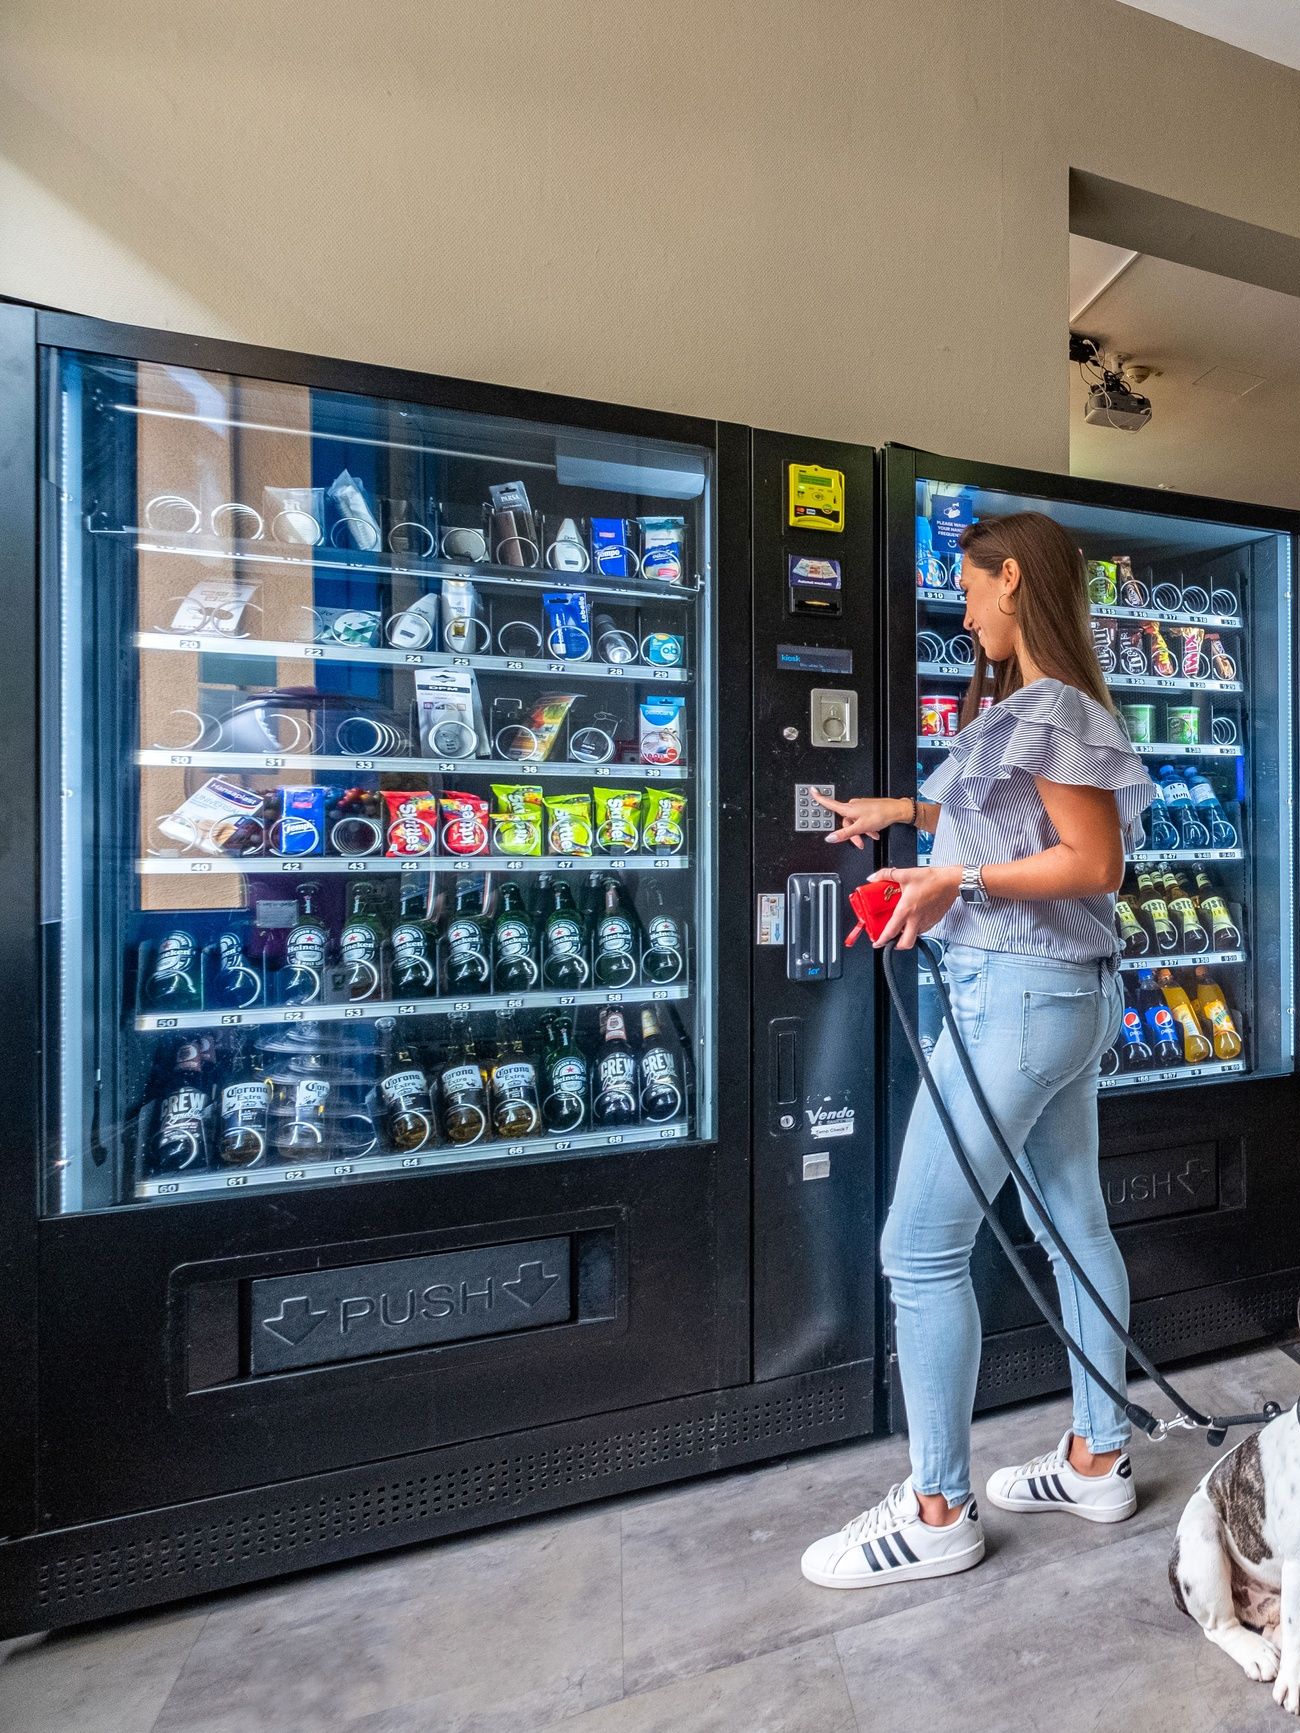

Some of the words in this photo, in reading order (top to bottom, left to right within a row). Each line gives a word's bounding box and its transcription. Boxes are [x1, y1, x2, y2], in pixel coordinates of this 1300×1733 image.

[181, 641, 199, 649] 20
[305, 648, 323, 656] 22
[406, 655, 422, 663] 24
[454, 658, 470, 666] 25
[508, 661, 523, 669] 26
[942, 666, 958, 674] 920
[655, 671, 668, 679] 29
[172, 756, 189, 765] 30
[266, 758, 283, 767] 31
[356, 761, 373, 769] 33
[440, 763, 455, 771] 34
[210, 782, 257, 805] Hansaplast
[400, 803, 422, 851] Skittles
[459, 804, 475, 844] kittles
[191, 863, 210, 871] 40
[283, 862, 301, 870] 42
[349, 863, 365, 871] 43
[401, 862, 418, 870] 44
[454, 861, 470, 870] 45
[611, 860, 625, 868] 48
[655, 860, 668, 868] 49
[287, 944, 325, 952] Heineke
[508, 999, 523, 1007] 56
[560, 996, 574, 1004] 57
[399, 1006, 415, 1014] 54
[454, 1003, 470, 1011] 55
[285, 1012, 302, 1020] 52
[346, 1009, 361, 1017] 53
[157, 1019, 175, 1027] 50
[222, 1015, 239, 1024] 51
[643, 1053, 675, 1077] CREW
[496, 1066, 529, 1079] Corona
[601, 1058, 634, 1081] CREW
[384, 1074, 420, 1089] Corona
[227, 1086, 268, 1099] Corona
[238, 1093, 261, 1101] Extra
[161, 1092, 205, 1116] CREW
[805, 1106, 855, 1125] Vendo
[556, 1142, 570, 1150] 67
[508, 1147, 523, 1155] 66
[403, 1158, 418, 1167] 64
[335, 1166, 351, 1174] 63
[286, 1171, 303, 1180] 62
[228, 1178, 245, 1186] 61
[160, 1184, 178, 1193] 60
[1107, 1171, 1171, 1207] USH
[340, 1277, 494, 1334] PUSH
